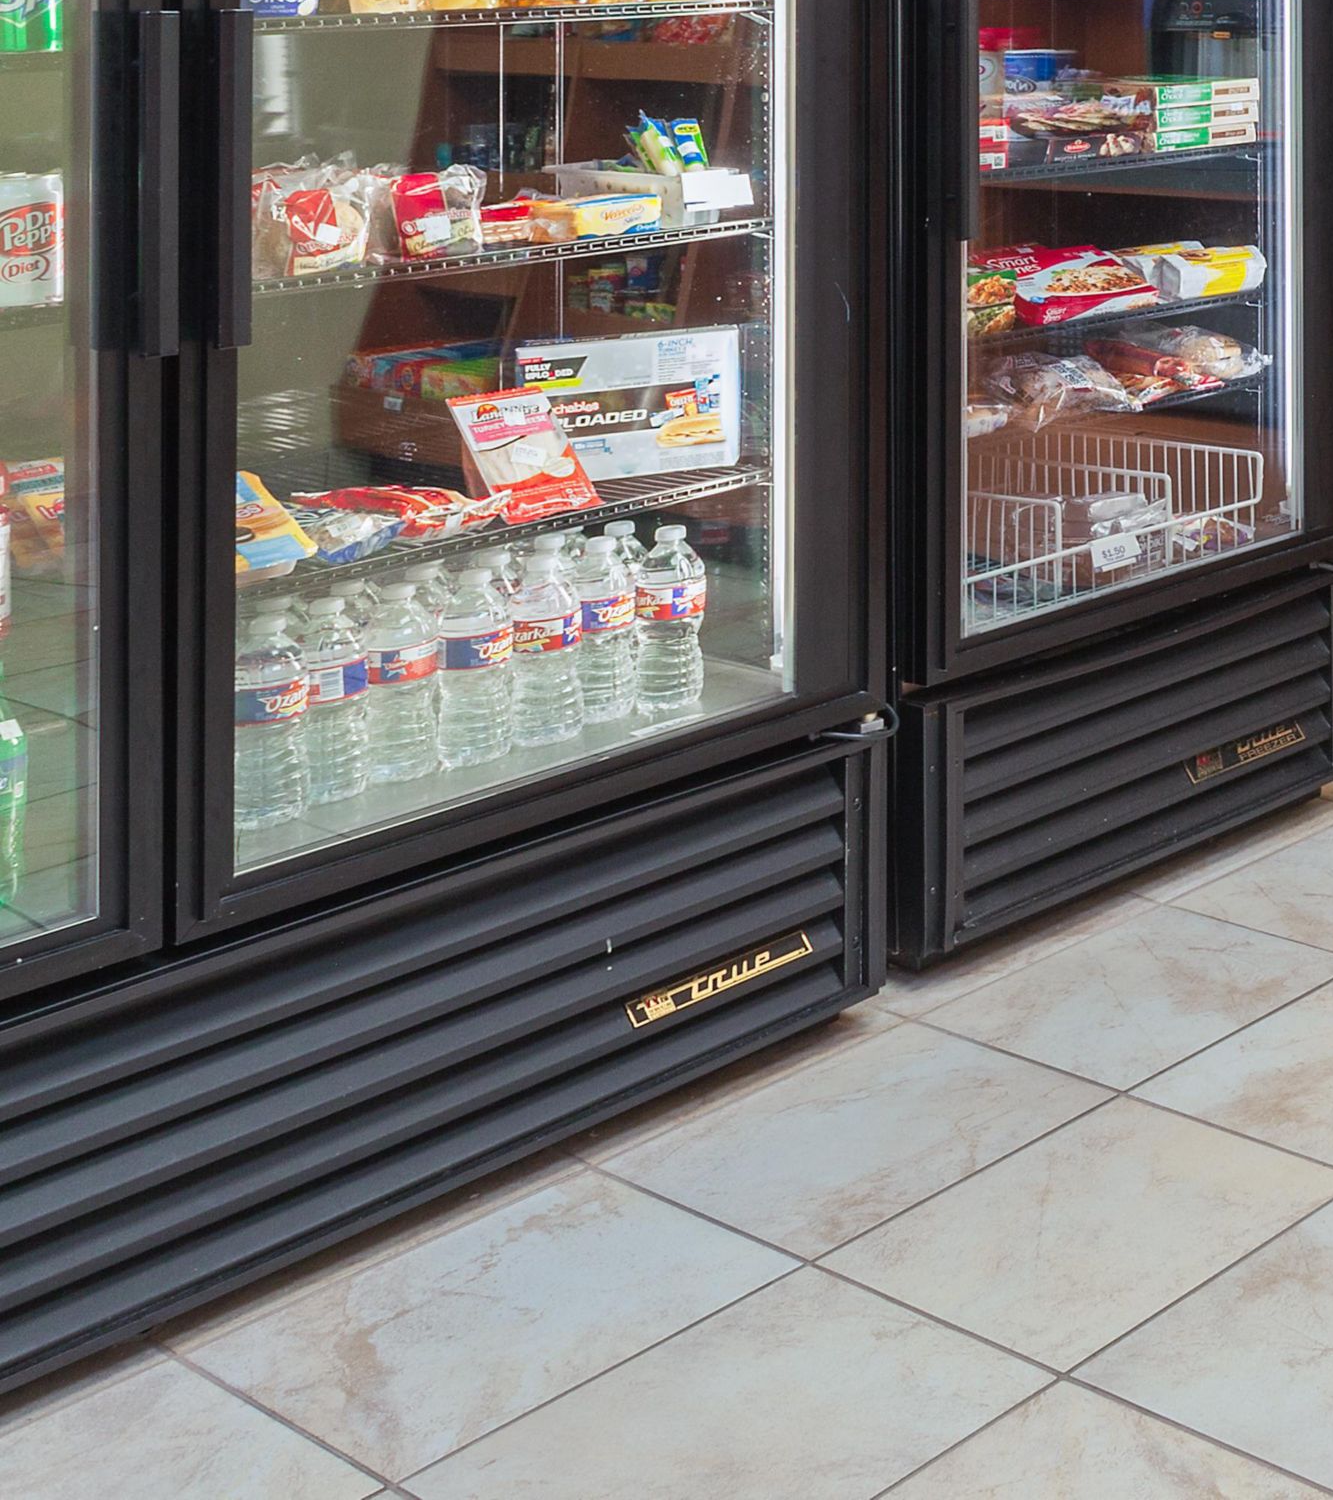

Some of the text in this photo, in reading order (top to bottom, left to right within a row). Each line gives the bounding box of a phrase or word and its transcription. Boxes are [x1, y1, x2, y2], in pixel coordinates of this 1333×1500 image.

[26, 210, 54, 232] Dr
[8, 260, 40, 278] Diet
[1014, 263, 1042, 276] nes
[597, 601, 635, 622] Ozar
[478, 633, 513, 659] Ozar
[264, 686, 309, 713] Ozar
[1239, 733, 1297, 761] FREEZER
